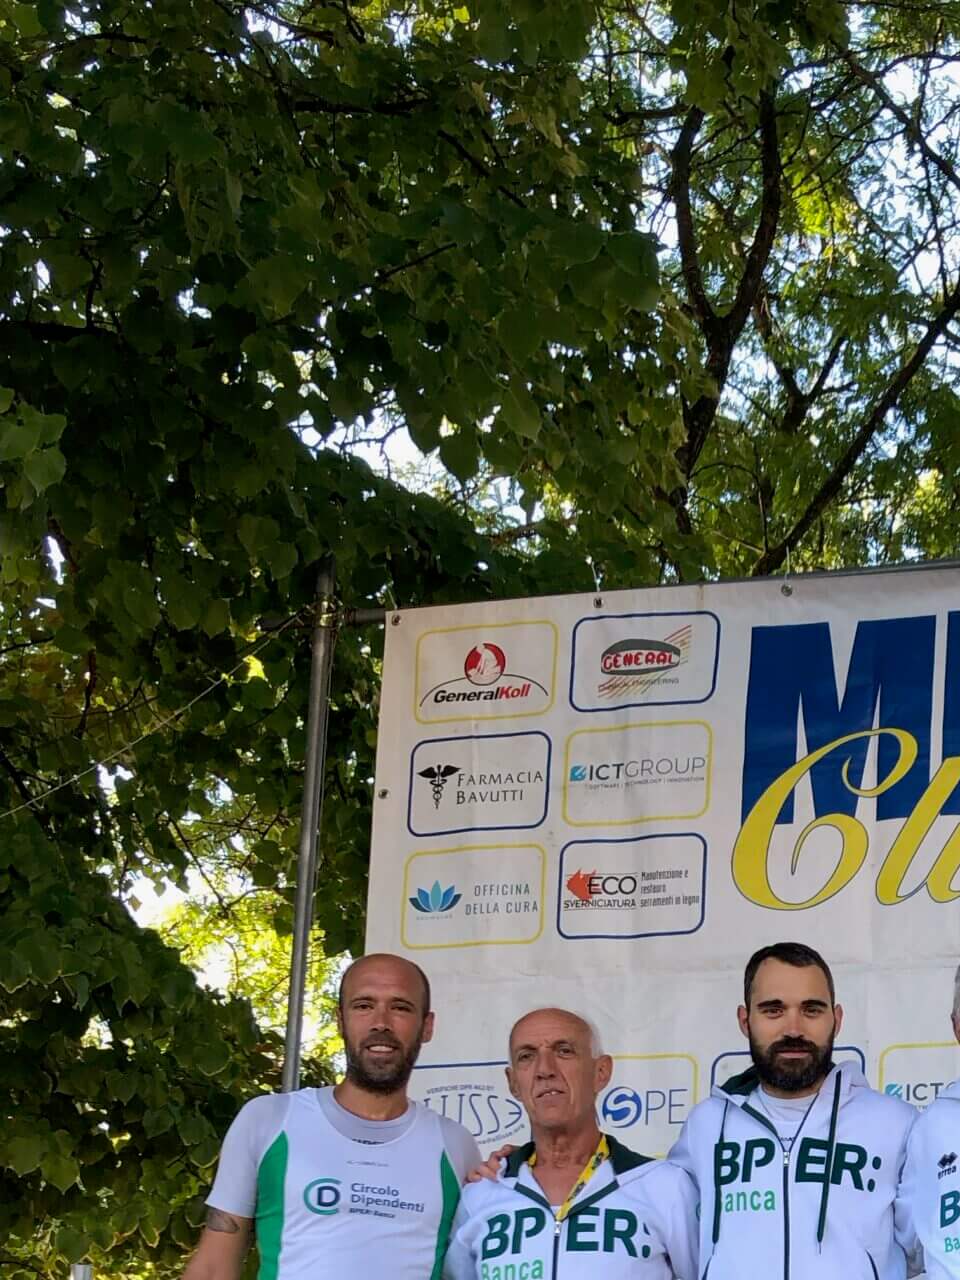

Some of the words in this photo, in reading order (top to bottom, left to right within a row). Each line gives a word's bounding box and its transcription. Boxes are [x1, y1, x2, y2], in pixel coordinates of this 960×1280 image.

[433, 683, 532, 705] GeneralKoll
[474, 883, 530, 897] OFFICINA
[588, 876, 638, 896] ECO
[465, 902, 500, 916] DELLA
[506, 901, 539, 914] CURA
[351, 1182, 399, 1197] Circolo
[351, 1194, 425, 1213] Dipendenti
[721, 1190, 776, 1213] anca
